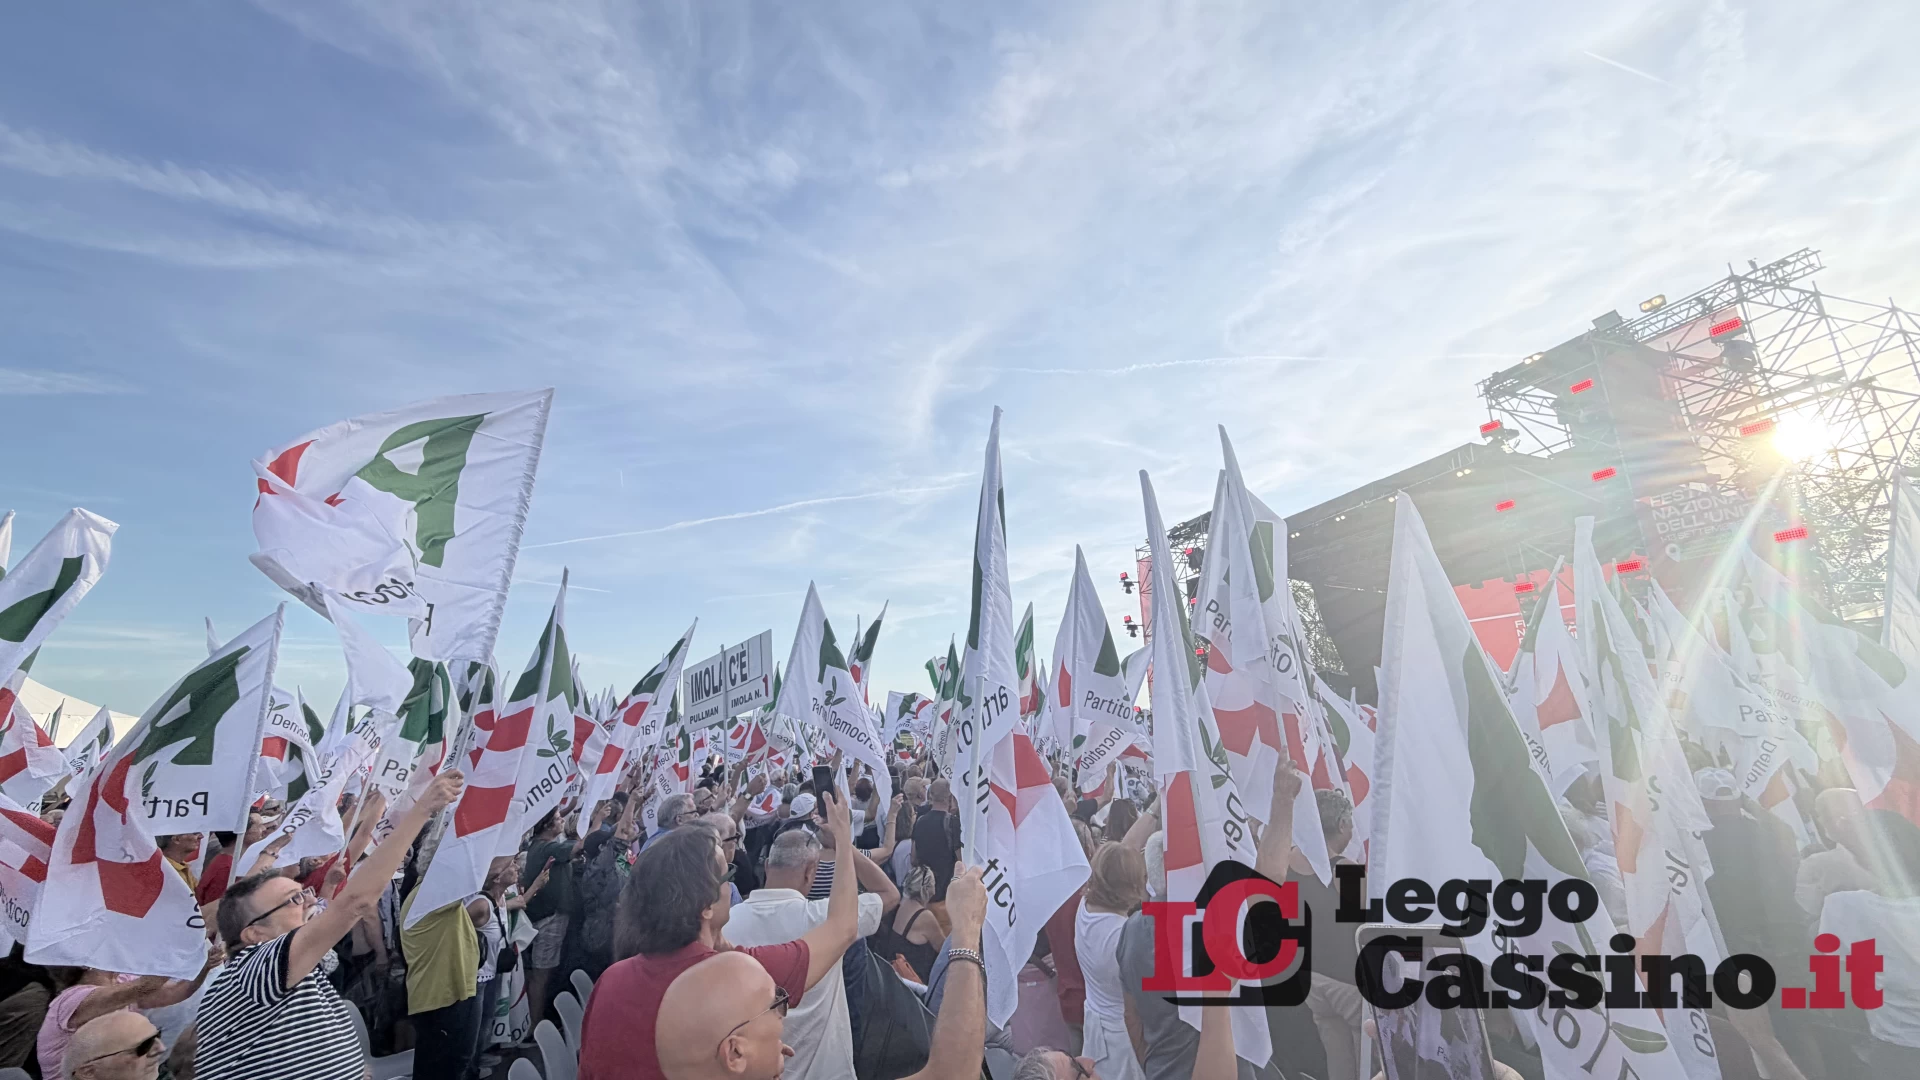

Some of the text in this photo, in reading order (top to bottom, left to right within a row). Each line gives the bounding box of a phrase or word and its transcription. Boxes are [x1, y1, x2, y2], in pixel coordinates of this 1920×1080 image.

[1652, 490, 1760, 520] NAZIONAL
[1656, 502, 1754, 535] DELL'UNIT
[691, 661, 723, 703] IMOLA
[689, 706, 719, 724] PULLMAN
[731, 692, 753, 708] IMOLA
[1083, 690, 1131, 720] Partito
